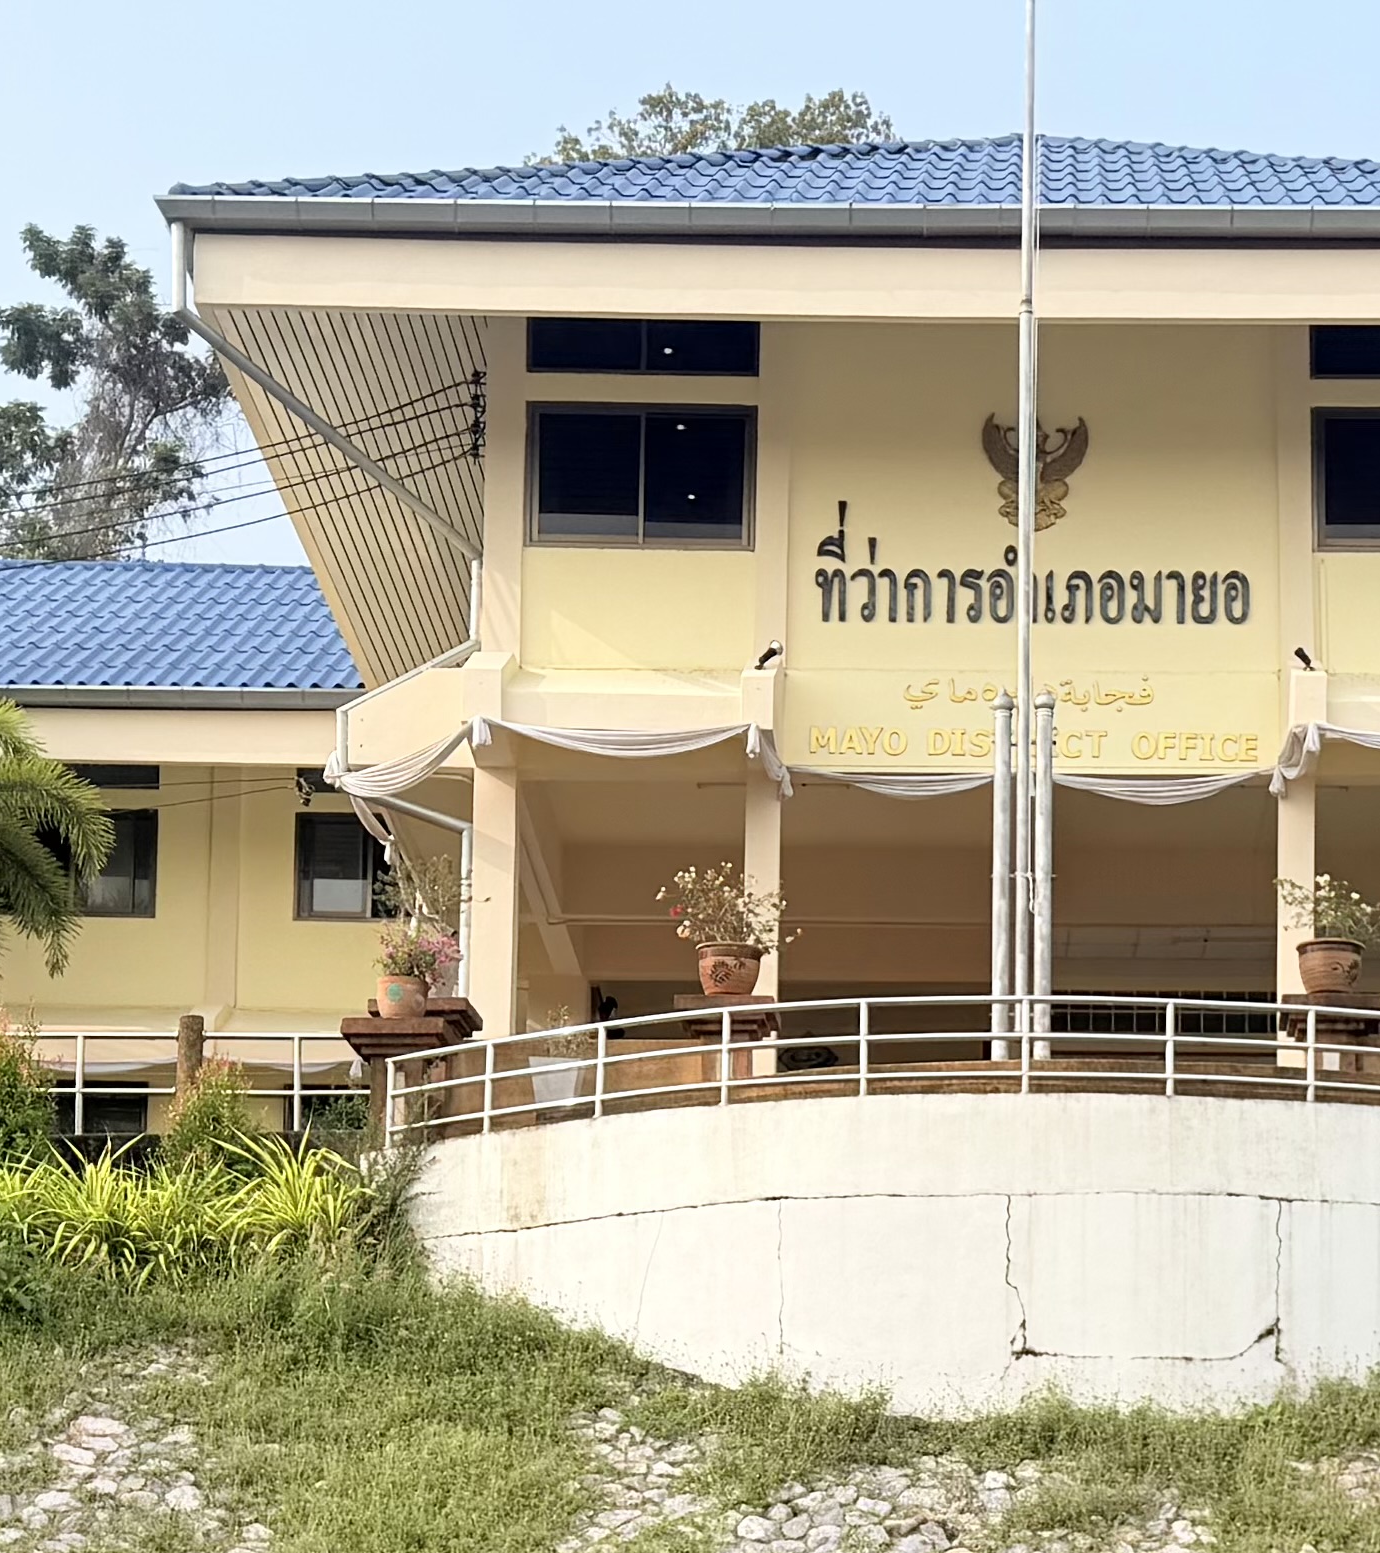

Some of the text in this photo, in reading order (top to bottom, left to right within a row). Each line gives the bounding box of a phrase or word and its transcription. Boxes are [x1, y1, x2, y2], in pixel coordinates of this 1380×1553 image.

[815, 500, 1250, 625] ที่ว่าการอำเภอมายอ
[809, 726, 1258, 762] MAYO DISCT OFFICE
